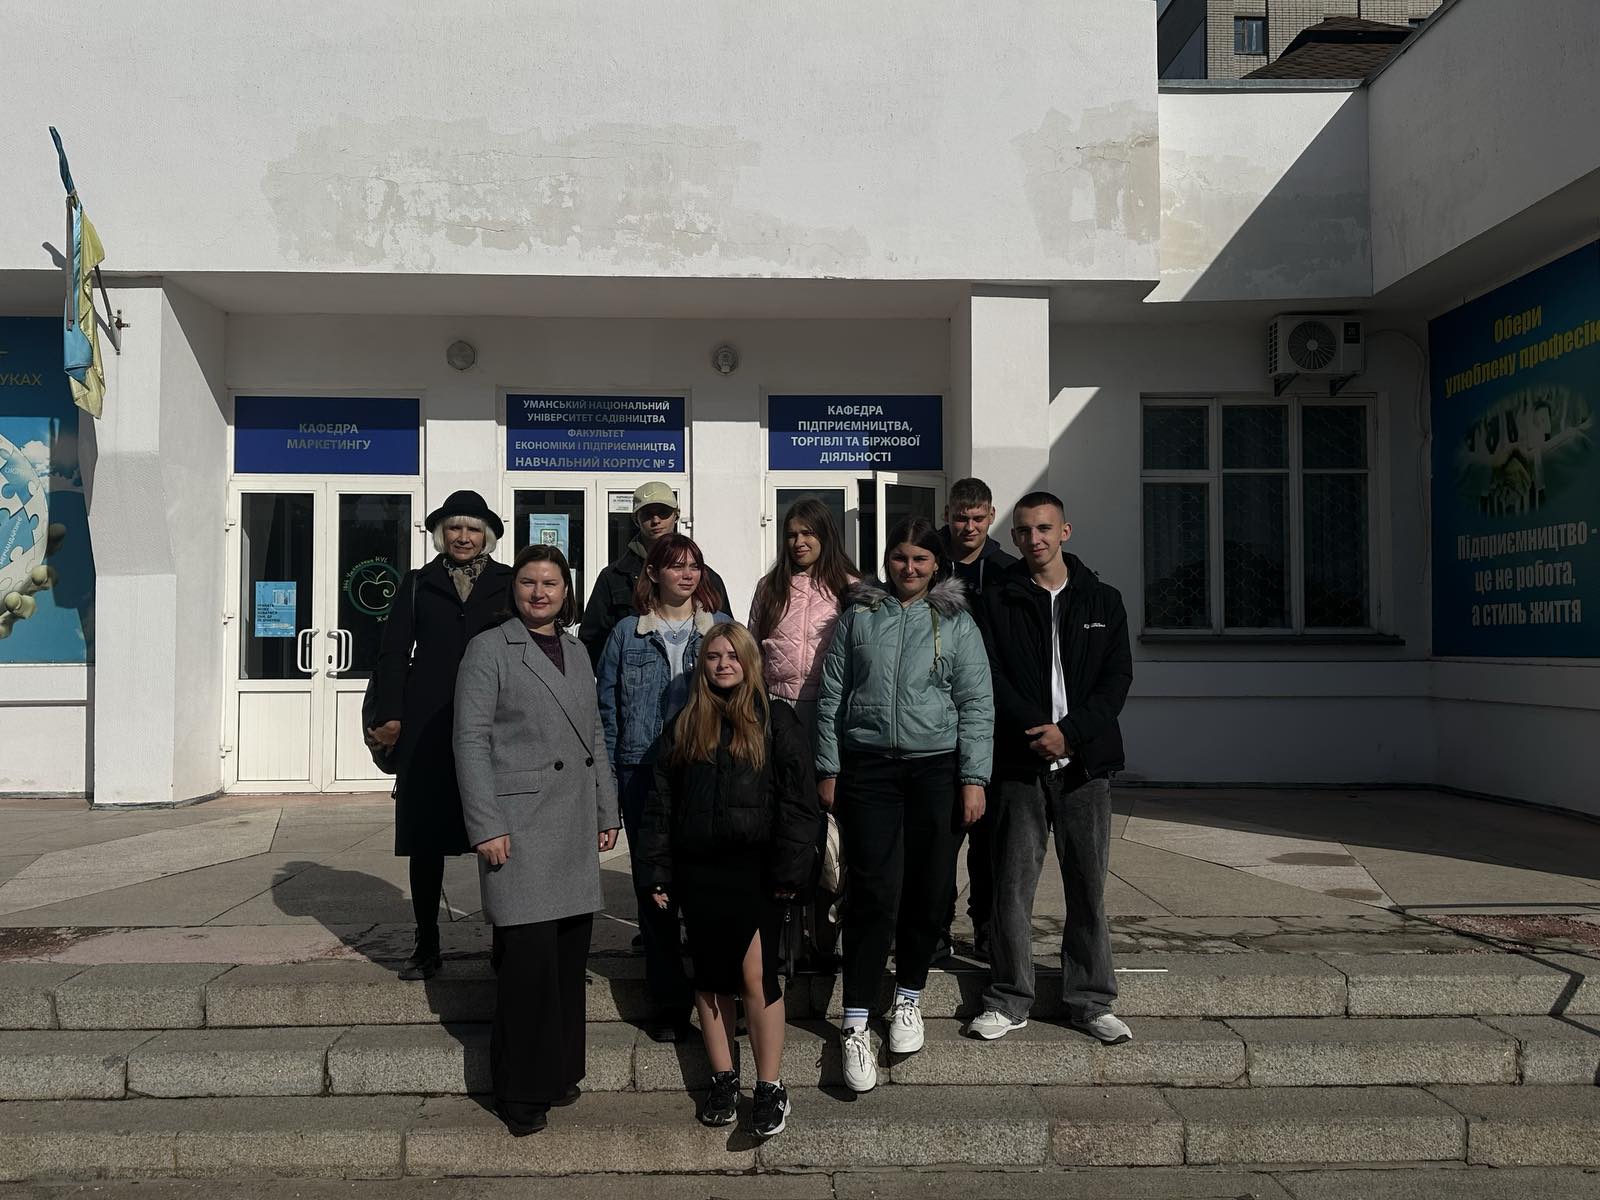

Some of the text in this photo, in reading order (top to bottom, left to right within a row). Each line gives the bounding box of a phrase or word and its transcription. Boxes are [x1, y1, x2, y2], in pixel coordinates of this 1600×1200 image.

[1494, 305, 1542, 343] Обери
[0, 373, 42, 386] УКАХ
[1445, 353, 1516, 399] улюблену
[523, 400, 670, 411] УМАНСЬКИЙ НАЦІОНАЛЬНИЙ
[827, 405, 884, 417] КАФЕДРА
[527, 413, 666, 424] УНІВЕРСИТЕТ САДІВНИЦТВА
[299, 423, 359, 436] КАФЕДРА
[567, 428, 625, 438] ФАКУЛЬТЕТ
[798, 420, 913, 433] ПІДПРИЄМНИЦТВА,
[287, 438, 371, 450] МАРКЕТИНГУ
[515, 441, 576, 450] ЕКОНОМІКИ
[583, 441, 676, 452] ПІДПРИЄМНИЦТВА
[791, 434, 921, 447] ТОРГІВЛІ ТА БІРЖОВОЇ
[515, 456, 675, 468] НАВЧАЛЬНИЙ КОРПУС № 5
[820, 452, 891, 464] ДІЯЛЬНОСТІ
[1457, 521, 1588, 562] Підприємництво
[1475, 560, 1576, 595] це не робота,
[1472, 599, 1582, 626] а стиль життя
